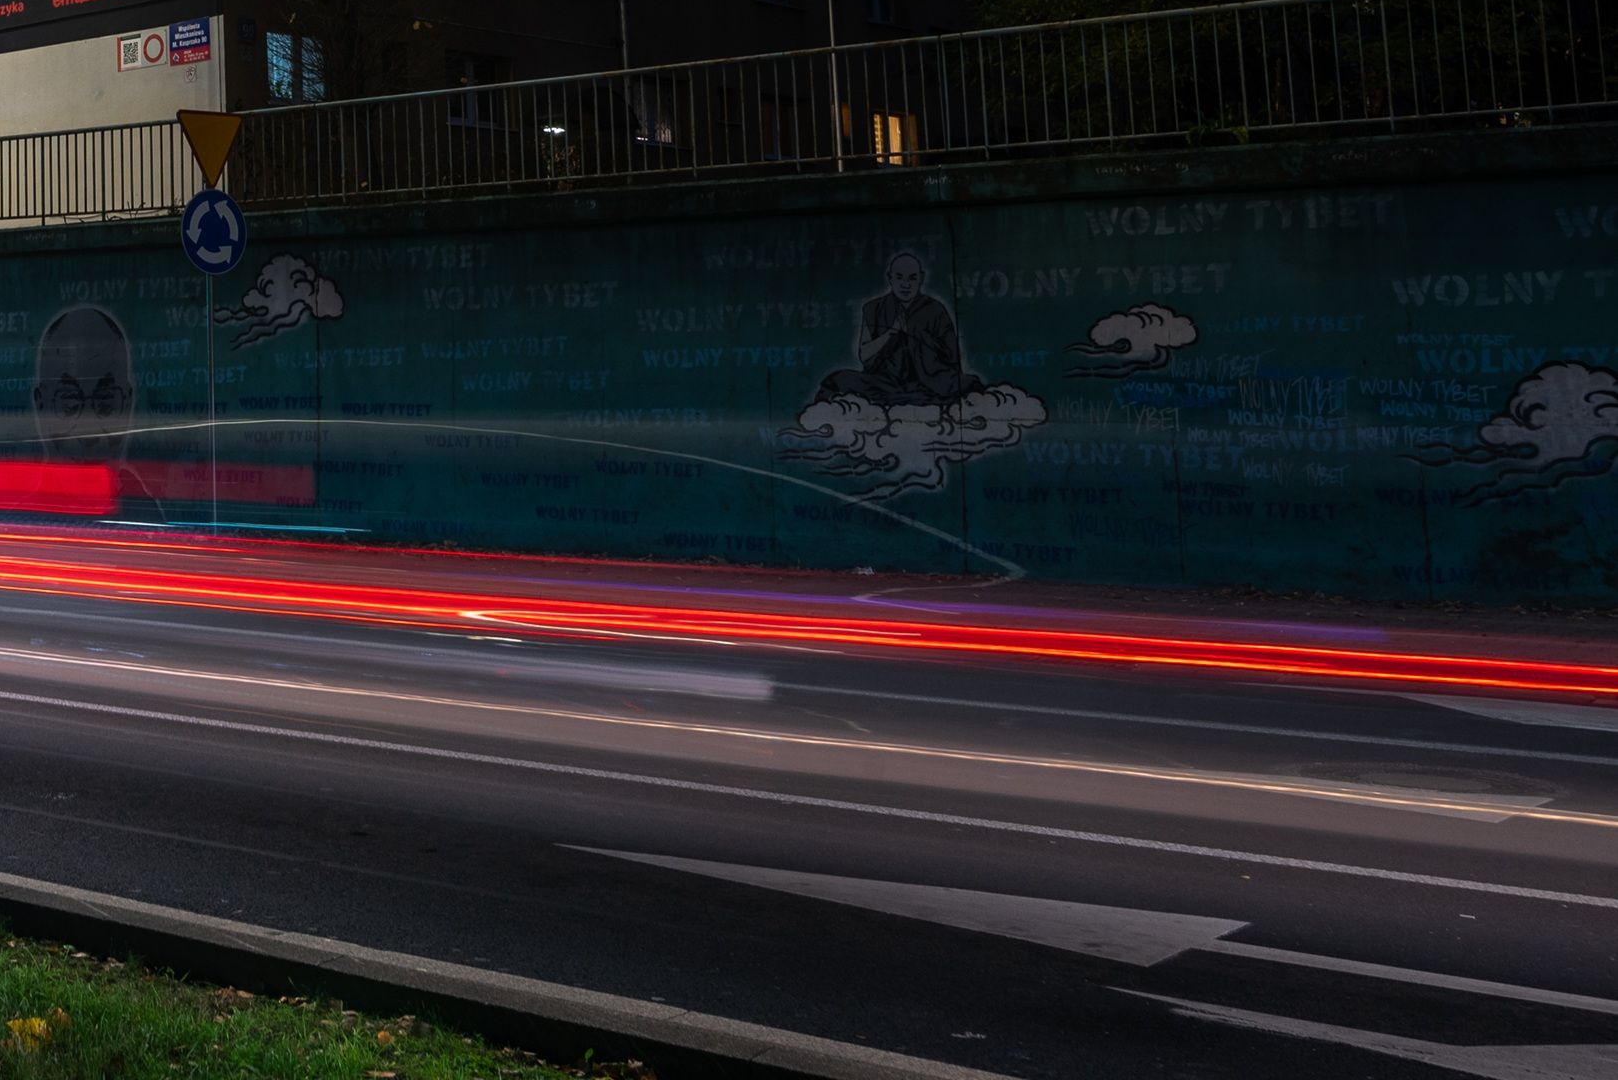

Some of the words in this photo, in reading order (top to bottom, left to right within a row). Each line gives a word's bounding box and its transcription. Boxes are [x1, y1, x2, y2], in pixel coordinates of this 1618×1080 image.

[1085, 202, 1228, 237] WOLNY
[1245, 194, 1394, 230] TYBET
[59, 279, 128, 301] WOLNY
[136, 276, 204, 299] TYBET
[950, 266, 1082, 299] WOLNY
[1095, 261, 1232, 296] TYBET
[1391, 270, 1564, 308] WOLNY
[422, 285, 515, 312] WOLNY
[526, 280, 619, 309] TYBET
[635, 303, 744, 335] WOLNY
[1292, 313, 1366, 333] TYBET
[139, 339, 190, 358] TYBET
[1396, 332, 1454, 345] WOLNY
[342, 346, 406, 368] TYBET
[421, 339, 494, 361] WOLNY
[642, 347, 724, 369] WOLNY
[732, 344, 815, 368] TYBET
[987, 349, 1050, 367] TYBET
[1416, 346, 1548, 375] WOLNY
[462, 371, 532, 392] WOLNY
[1122, 381, 1175, 396] WOLNY
[1185, 382, 1237, 400] TYBET
[1358, 378, 1425, 400] WOLNY
[1431, 379, 1499, 405] TYBET
[239, 396, 280, 410] WOLNY
[284, 395, 324, 410] TYBET
[1239, 377, 1291, 418] WOLNY
[341, 401, 387, 416] WOLNY
[388, 402, 433, 417] TYBET
[1055, 395, 1114, 432] WOLNY
[1121, 400, 1182, 436] TYBET
[1227, 408, 1285, 428] WOLNY
[1381, 400, 1438, 419] WOLNY
[1444, 404, 1495, 422] TYBET
[244, 430, 284, 442] WOLNY
[425, 434, 471, 449] WOLNY
[477, 434, 522, 449] TYBET
[1187, 426, 1233, 445] WOLNY
[1239, 430, 1280, 449] TYBET
[1023, 441, 1127, 466] WOLNY
[1138, 443, 1244, 471] TYBET
[479, 471, 529, 487] WOLNY
[532, 472, 581, 489] TYBET
[594, 459, 648, 476] WOLNY
[654, 461, 705, 479] TYBET
[1242, 457, 1294, 489] WOLNY
[1304, 462, 1352, 488] TYBET
[983, 486, 1052, 505] WOLNY
[1057, 487, 1124, 505] TYBET
[534, 503, 588, 521] WOLNY
[591, 506, 641, 525] TYBET
[793, 503, 853, 522] WOLNY
[1182, 500, 1256, 518] WOLNY
[1265, 502, 1341, 522] TYBET
[662, 531, 719, 549] WOLNY
[723, 534, 778, 552] TYBET
[1011, 542, 1077, 564] TYBET
